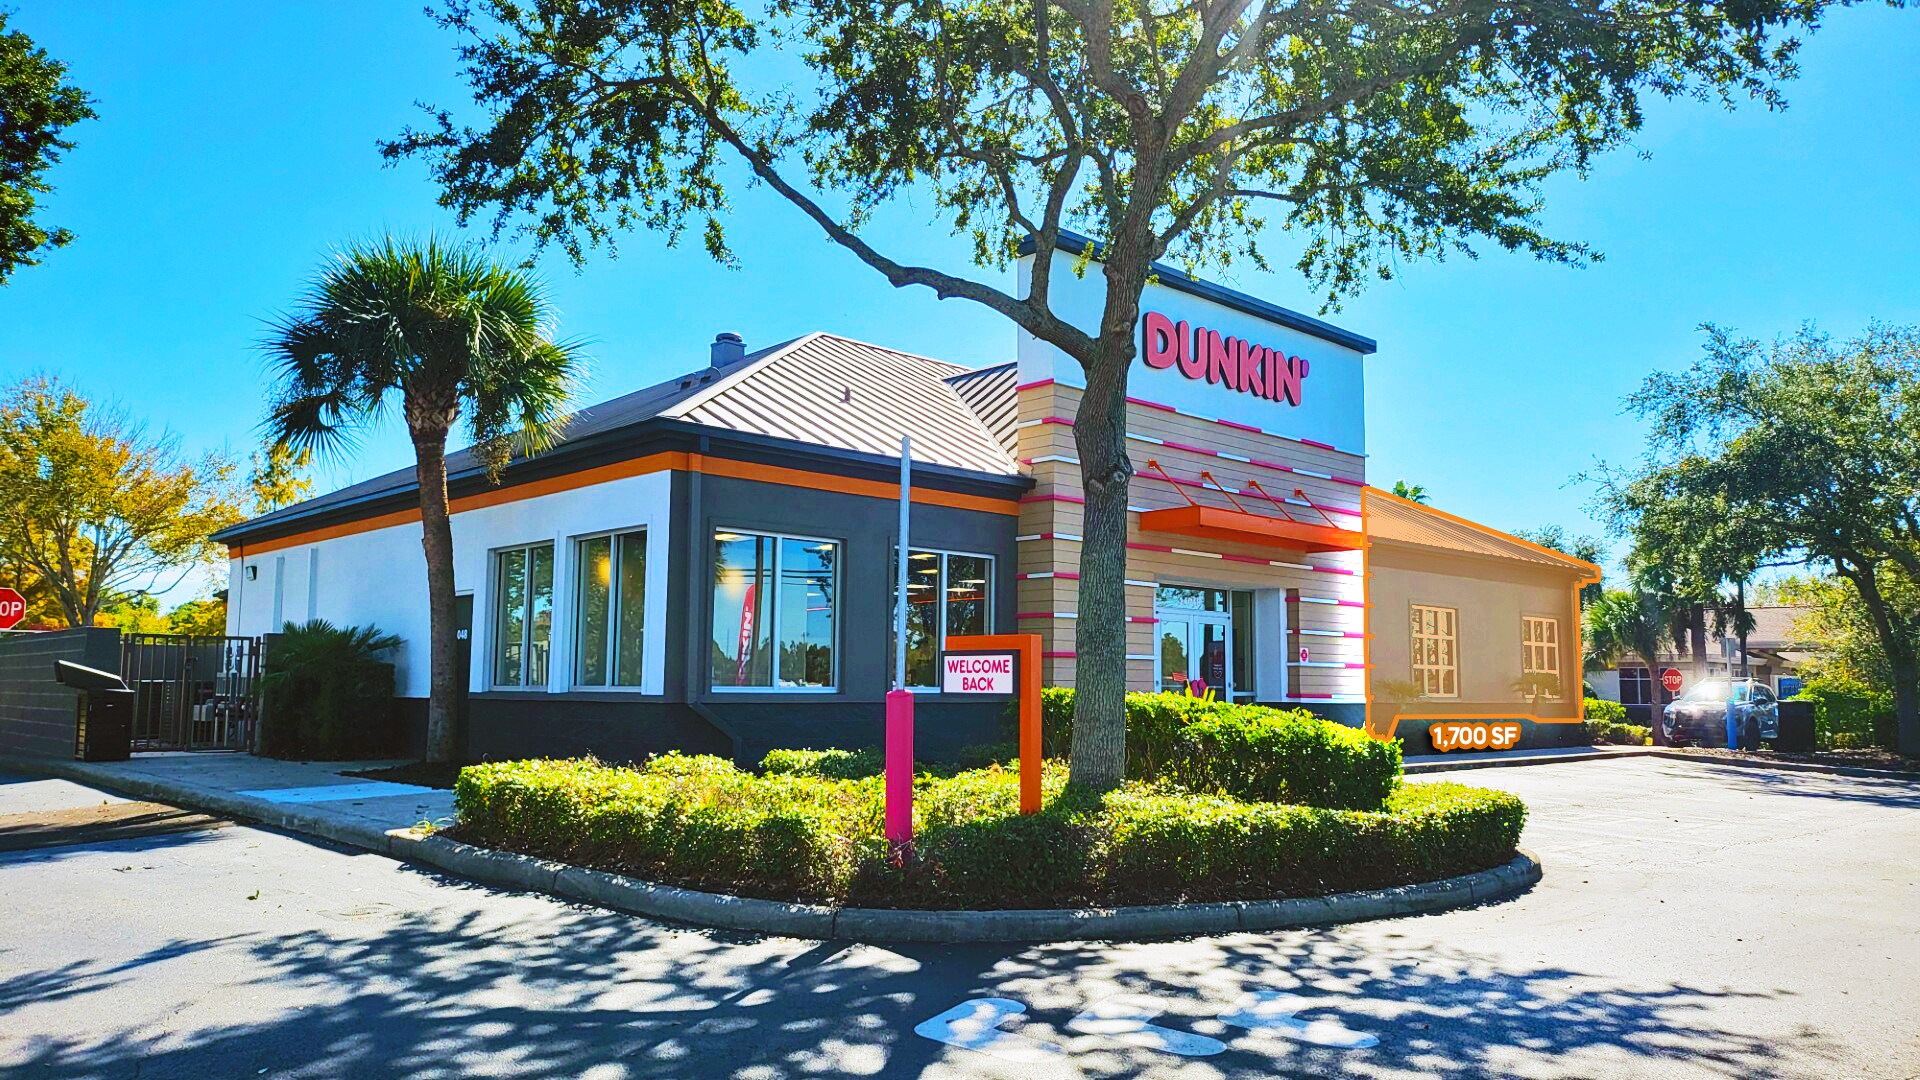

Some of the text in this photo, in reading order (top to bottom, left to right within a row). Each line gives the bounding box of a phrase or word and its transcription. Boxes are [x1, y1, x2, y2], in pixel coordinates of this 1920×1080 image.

[1143, 311, 1309, 406] DUNKIN'
[0, 601, 22, 617] OP
[948, 659, 1010, 673] WELCOME
[962, 677, 994, 691] BACK
[1664, 675, 1682, 685] STOP
